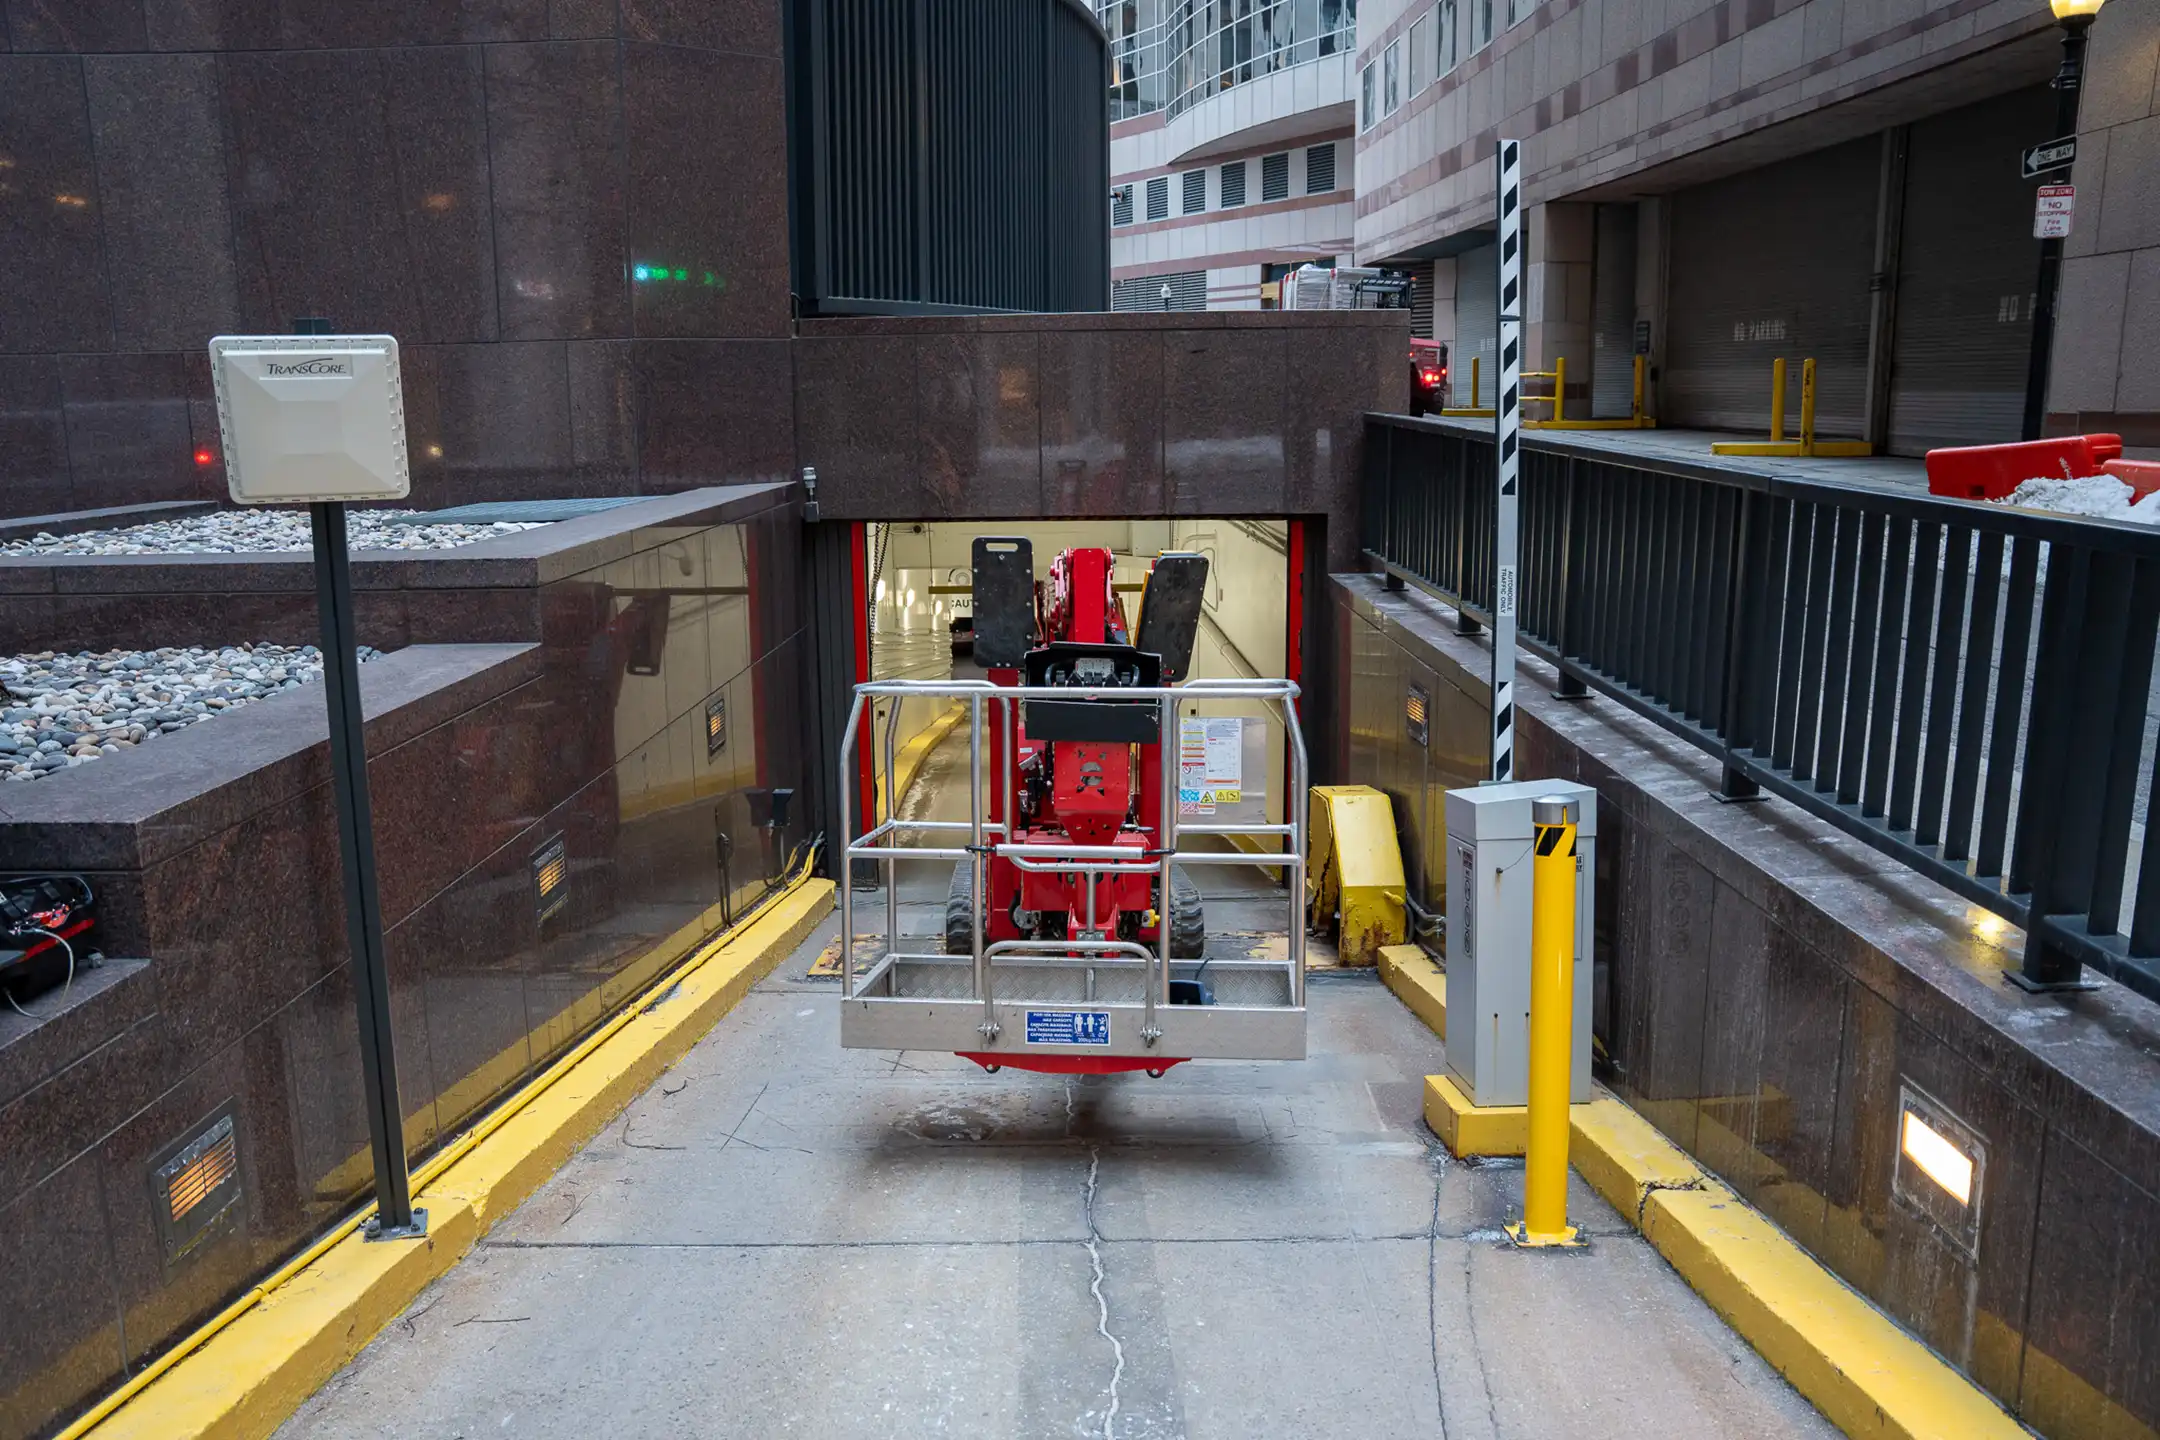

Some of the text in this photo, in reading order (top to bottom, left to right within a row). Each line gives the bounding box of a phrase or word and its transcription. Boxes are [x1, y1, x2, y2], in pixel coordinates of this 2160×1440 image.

[2037, 145, 2072, 163] ONE WAY
[1998, 294, 2019, 322] NO
[1734, 318, 1785, 341] NO PARKING
